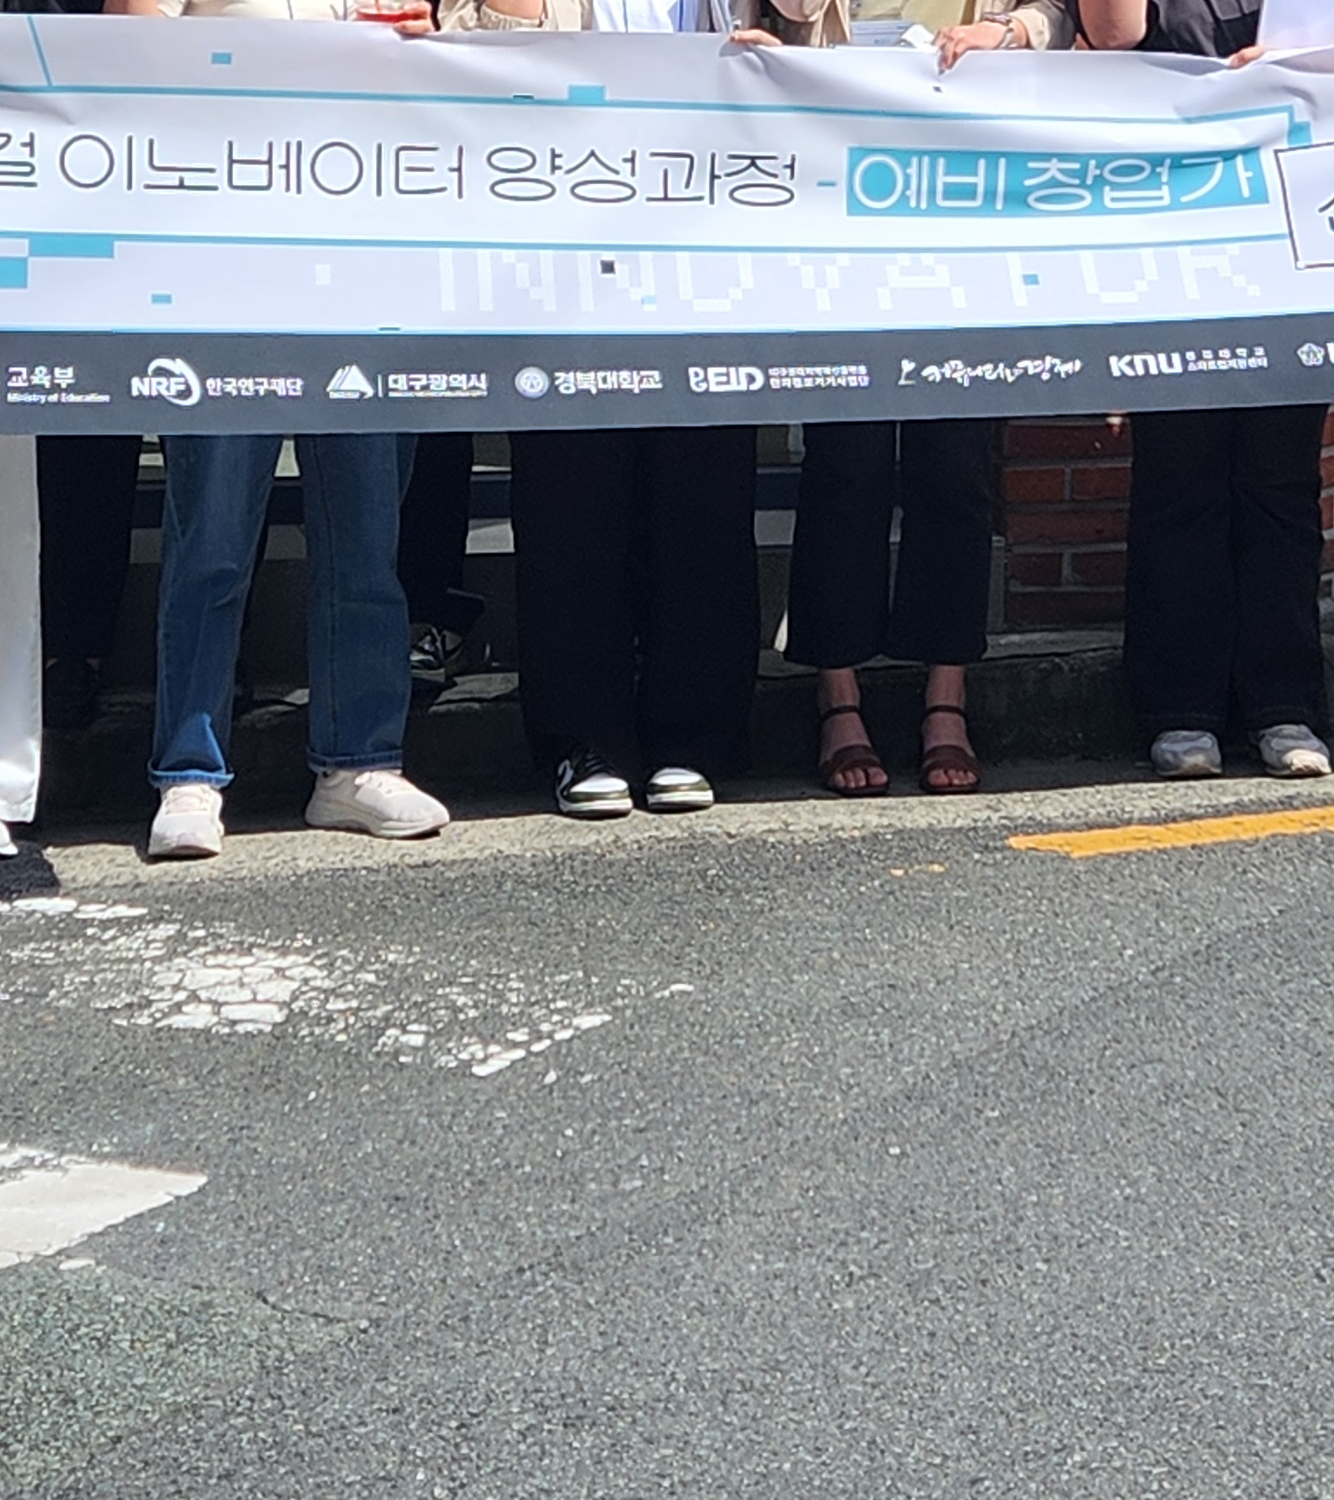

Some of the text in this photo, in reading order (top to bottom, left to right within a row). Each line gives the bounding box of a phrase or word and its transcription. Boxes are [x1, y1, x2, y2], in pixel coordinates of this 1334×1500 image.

[58, 132, 465, 199] 이노베이터
[485, 144, 798, 208] 양성과정
[851, 153, 1007, 212] 예비
[1022, 155, 1257, 213] 창업가
[1108, 351, 1184, 378] KNU
[7, 365, 76, 389] 교육부
[131, 376, 187, 397] NRF
[205, 376, 303, 397] 한국연구재단
[387, 373, 488, 392] 대구광역시
[554, 370, 663, 395] 경북대학교
